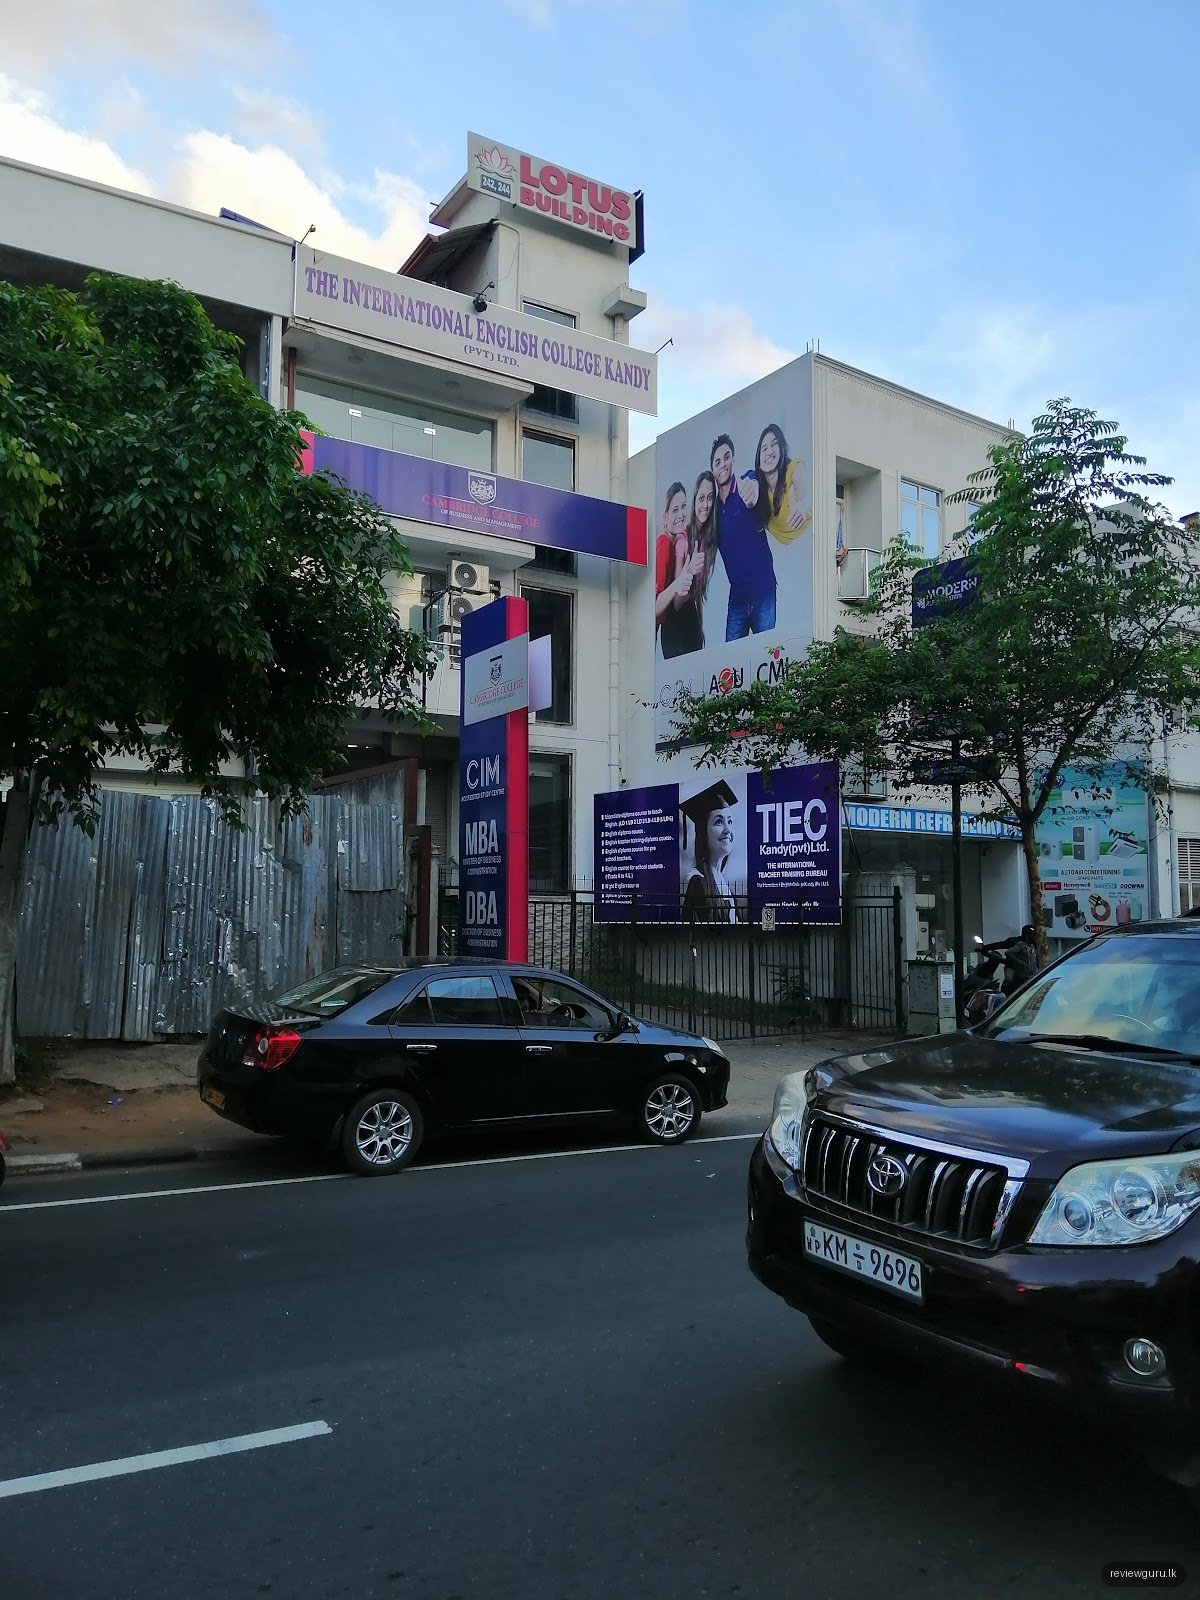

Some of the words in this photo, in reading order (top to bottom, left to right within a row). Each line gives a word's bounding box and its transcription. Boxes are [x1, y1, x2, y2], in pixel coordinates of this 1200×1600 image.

[482, 177, 496, 191] 242,
[498, 182, 511, 195] 244
[520, 155, 631, 220] LOTUS
[520, 186, 630, 240] BUILDING
[305, 266, 339, 300] THE
[342, 278, 473, 339] INTERNATIONAL
[476, 317, 538, 358] ENGLISH
[541, 338, 602, 377] COLLEGE
[605, 356, 651, 391] KANDY
[464, 344, 494, 362] (PVT)
[497, 353, 520, 367] LTD.
[422, 494, 489, 516] CAMBRIDGE
[492, 510, 540, 528] COLLEGE
[449, 510, 473, 520] BUSINESS
[486, 517, 522, 530] MANAGEMENT
[466, 754, 500, 789] CIM
[756, 798, 827, 843] TIEC
[842, 806, 911, 829] MODERN
[465, 819, 499, 855] MBA
[758, 871, 780, 879] TEACHER
[777, 861, 816, 869] INTERNATIONAL
[1063, 882, 1091, 890] Honeywell
[466, 890, 498, 924] DBA
[823, 1231, 848, 1264] KM
[870, 1249, 920, 1291] 9696
